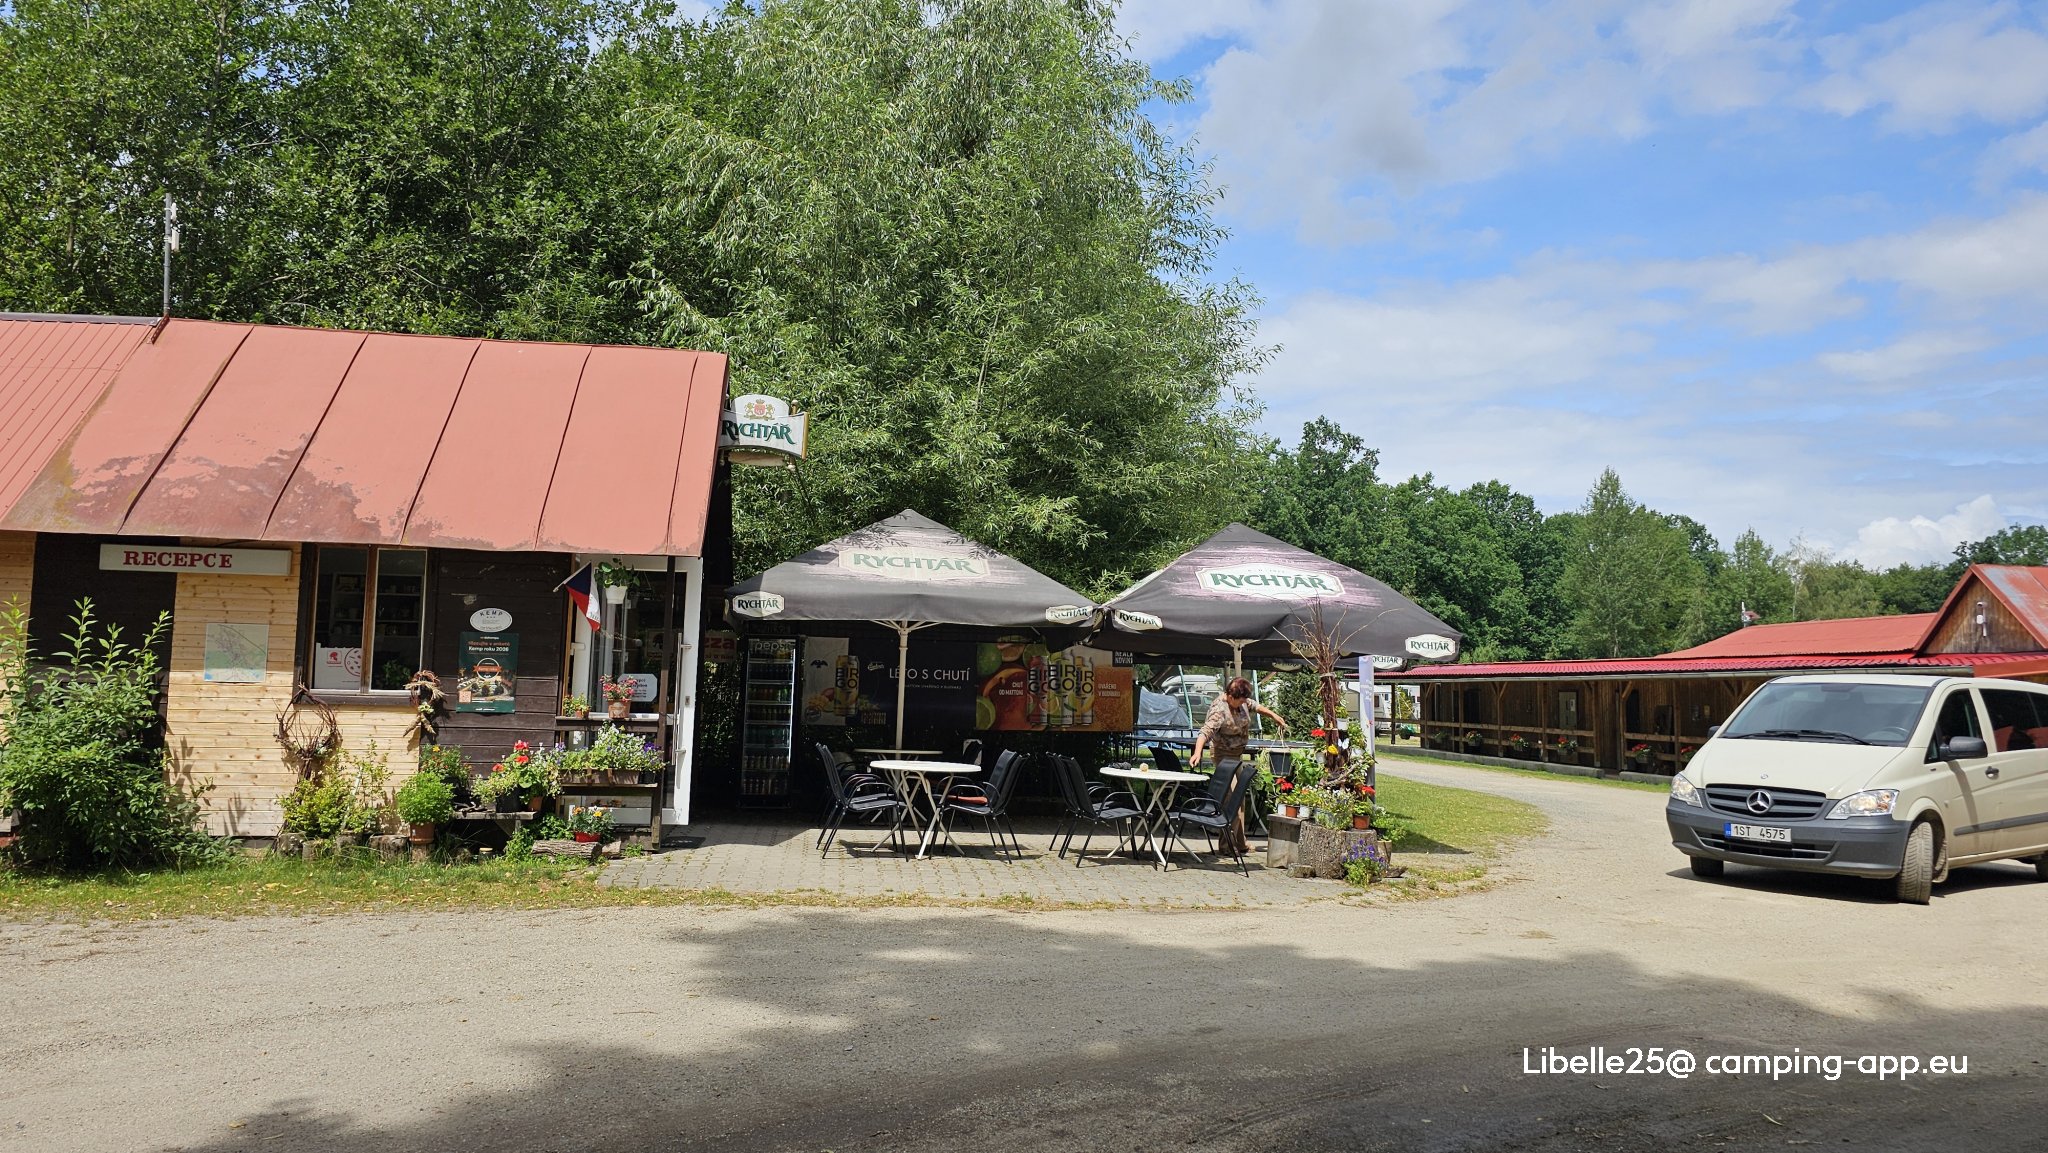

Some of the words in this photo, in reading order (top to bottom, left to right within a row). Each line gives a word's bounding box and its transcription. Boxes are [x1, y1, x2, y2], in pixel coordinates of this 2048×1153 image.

[721, 420, 797, 444] RYCHTÁŘ
[123, 551, 233, 568] RECEPCE
[853, 553, 981, 575] RYCHTÁŘ
[1210, 573, 1334, 592] RYCHTÁŘ
[737, 598, 781, 611] RYCHTÁŘ
[1410, 639, 1453, 653] RYCHTÁŘ
[889, 665, 918, 679] LÉO
[922, 669, 929, 680] S
[933, 667, 970, 681] CHUTÍ
[1049, 664, 1076, 677] BIR
[1049, 678, 1074, 691] GO
[1734, 825, 1751, 837] 1ST
[1760, 828, 1785, 839] 4575
